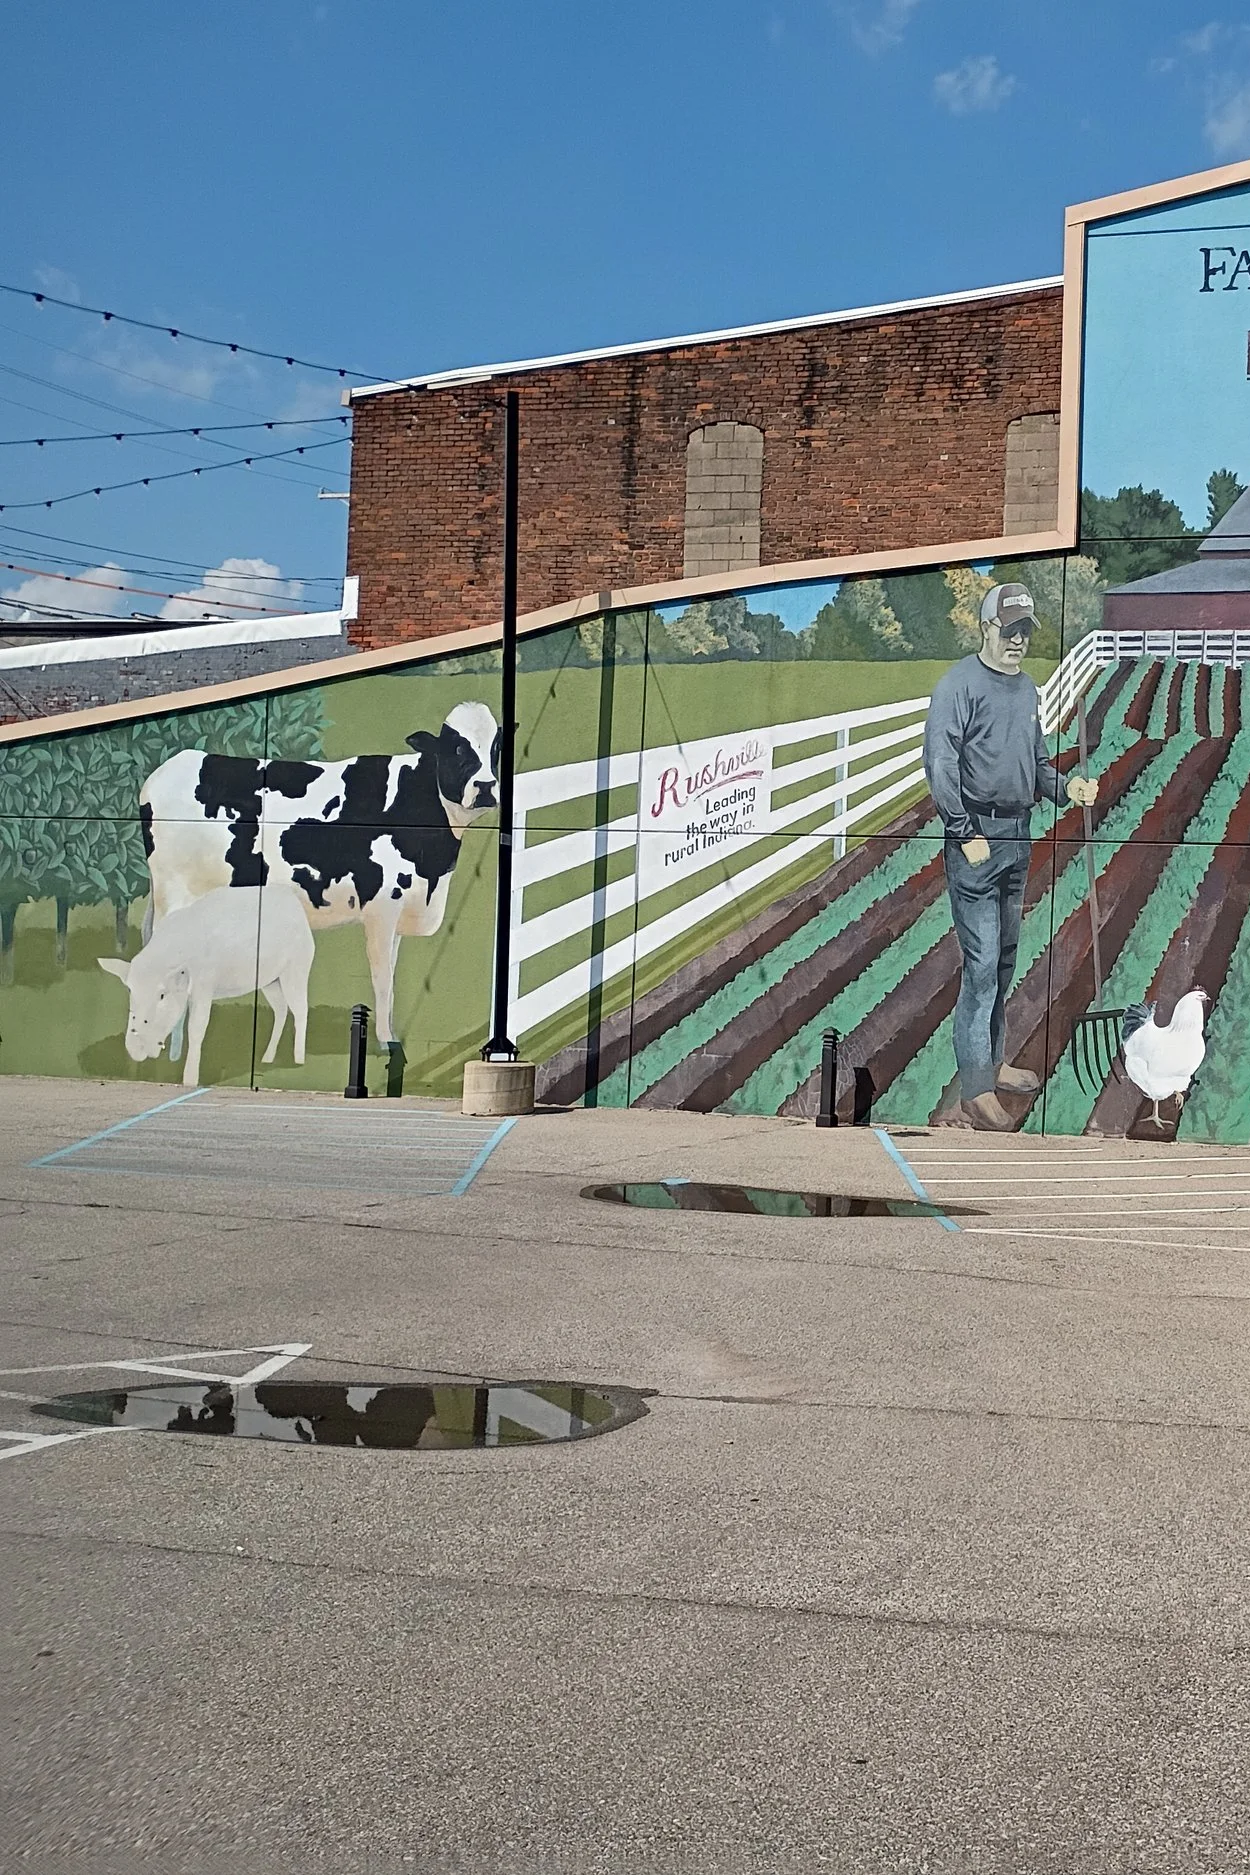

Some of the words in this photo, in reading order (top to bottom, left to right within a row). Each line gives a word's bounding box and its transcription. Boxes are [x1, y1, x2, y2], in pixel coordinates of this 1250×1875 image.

[651, 740, 767, 818] Rushville
[706, 787, 756, 815] Leading
[686, 822, 707, 840] the
[709, 810, 738, 829] way
[742, 802, 755, 816] in
[664, 838, 699, 866] rural
